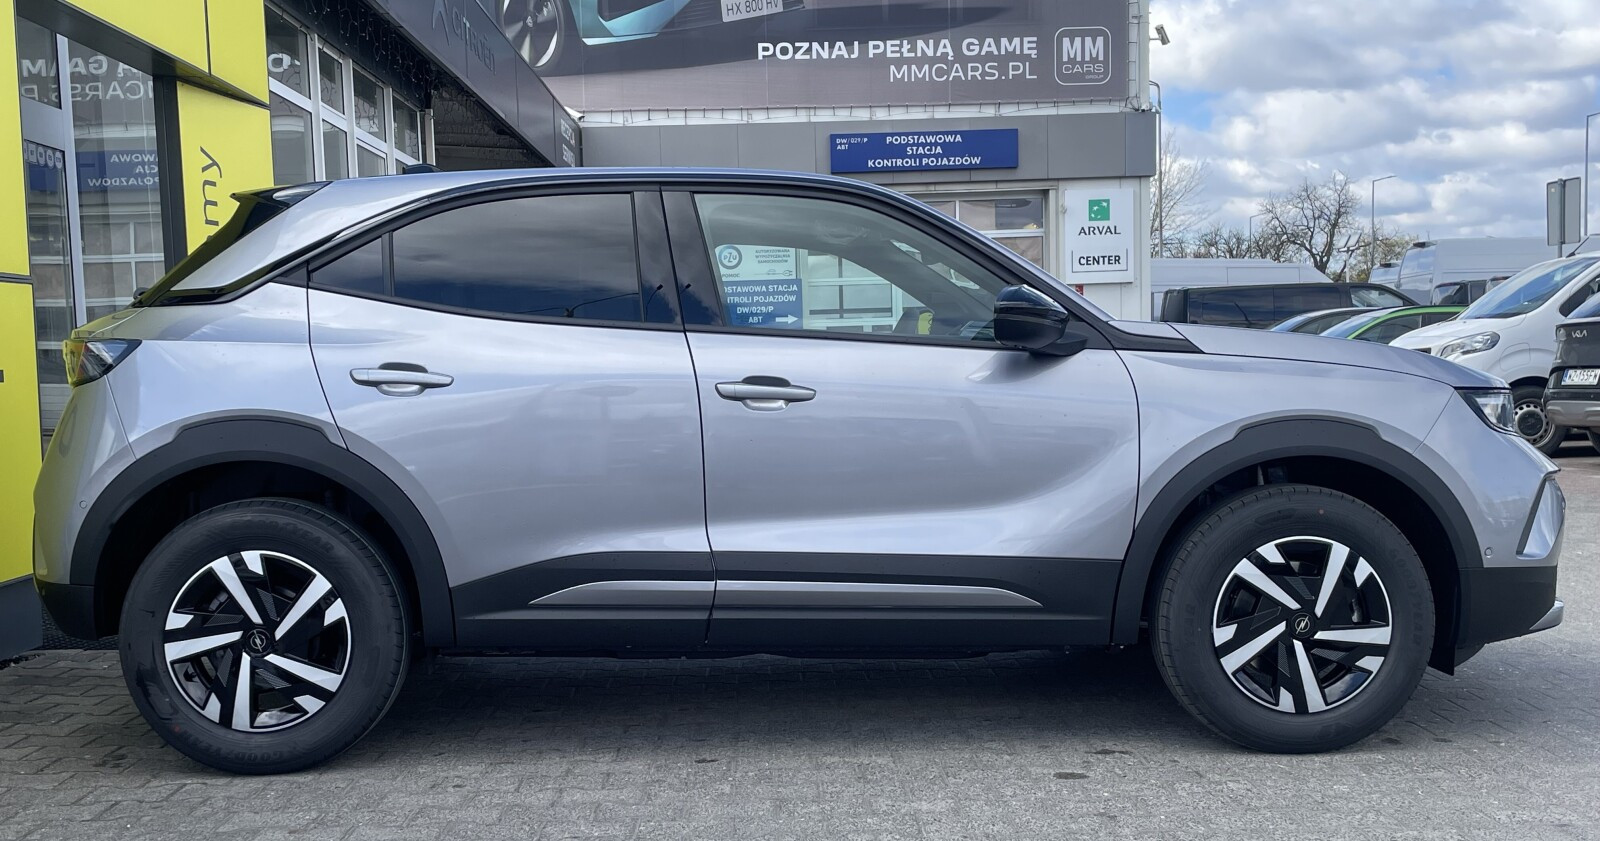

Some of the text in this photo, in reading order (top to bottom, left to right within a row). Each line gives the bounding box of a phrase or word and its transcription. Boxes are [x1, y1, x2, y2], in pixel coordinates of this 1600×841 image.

[726, 2, 743, 16] HX
[745, 0, 763, 13] 800
[757, 36, 1038, 60] POZNAJ PEŁNĄ GAMĘ
[1062, 36, 1104, 62] MM
[889, 62, 1037, 82] MMCARS.PL
[1062, 63, 1104, 73] CARS
[886, 134, 963, 145] PODSTAWOWA
[906, 145, 943, 155] STACJA
[868, 155, 982, 168] KONTROLI POJAZDÓW
[200, 146, 222, 241] my
[1078, 225, 1121, 236] ARVAL
[1078, 255, 1121, 266] CENTER
[768, 284, 798, 292] STACJA
[753, 294, 797, 303] POJAZDÓW
[736, 306, 774, 314] DW/029/P
[748, 316, 763, 324] ABT
